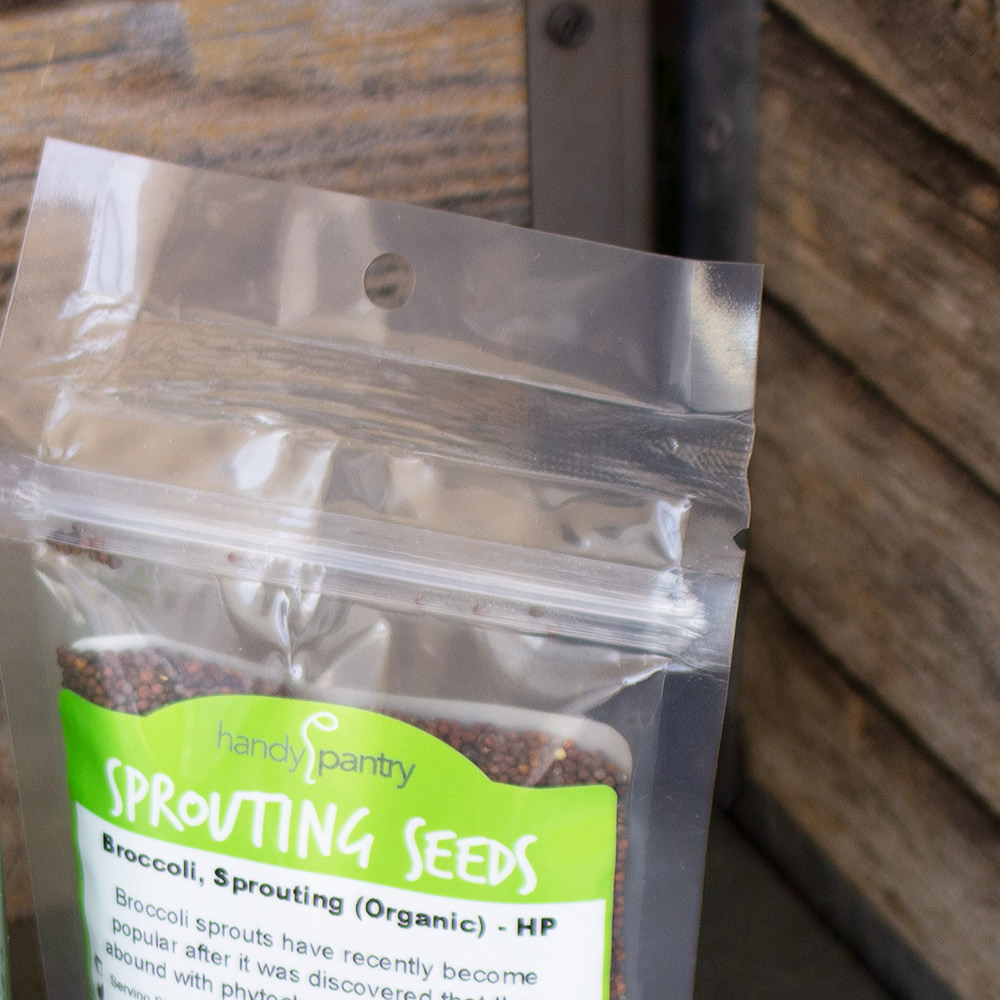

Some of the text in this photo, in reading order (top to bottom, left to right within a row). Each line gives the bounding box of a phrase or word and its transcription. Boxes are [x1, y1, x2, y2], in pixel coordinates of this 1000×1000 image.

[217, 720, 416, 789] handy pantry
[106, 757, 537, 895] SPROUTING SEEDS
[103, 832, 204, 887] Broccoli,
[214, 867, 344, 915] Sprouting
[356, 896, 486, 938] (Organic)
[517, 917, 557, 936] HP
[106, 941, 167, 980] abound
[174, 968, 213, 993] with
[112, 917, 178, 953] popular
[185, 943, 230, 968] after
[239, 952, 250, 973] it
[257, 961, 300, 983] was
[115, 886, 538, 985] Broccoli sprouts have recently become
